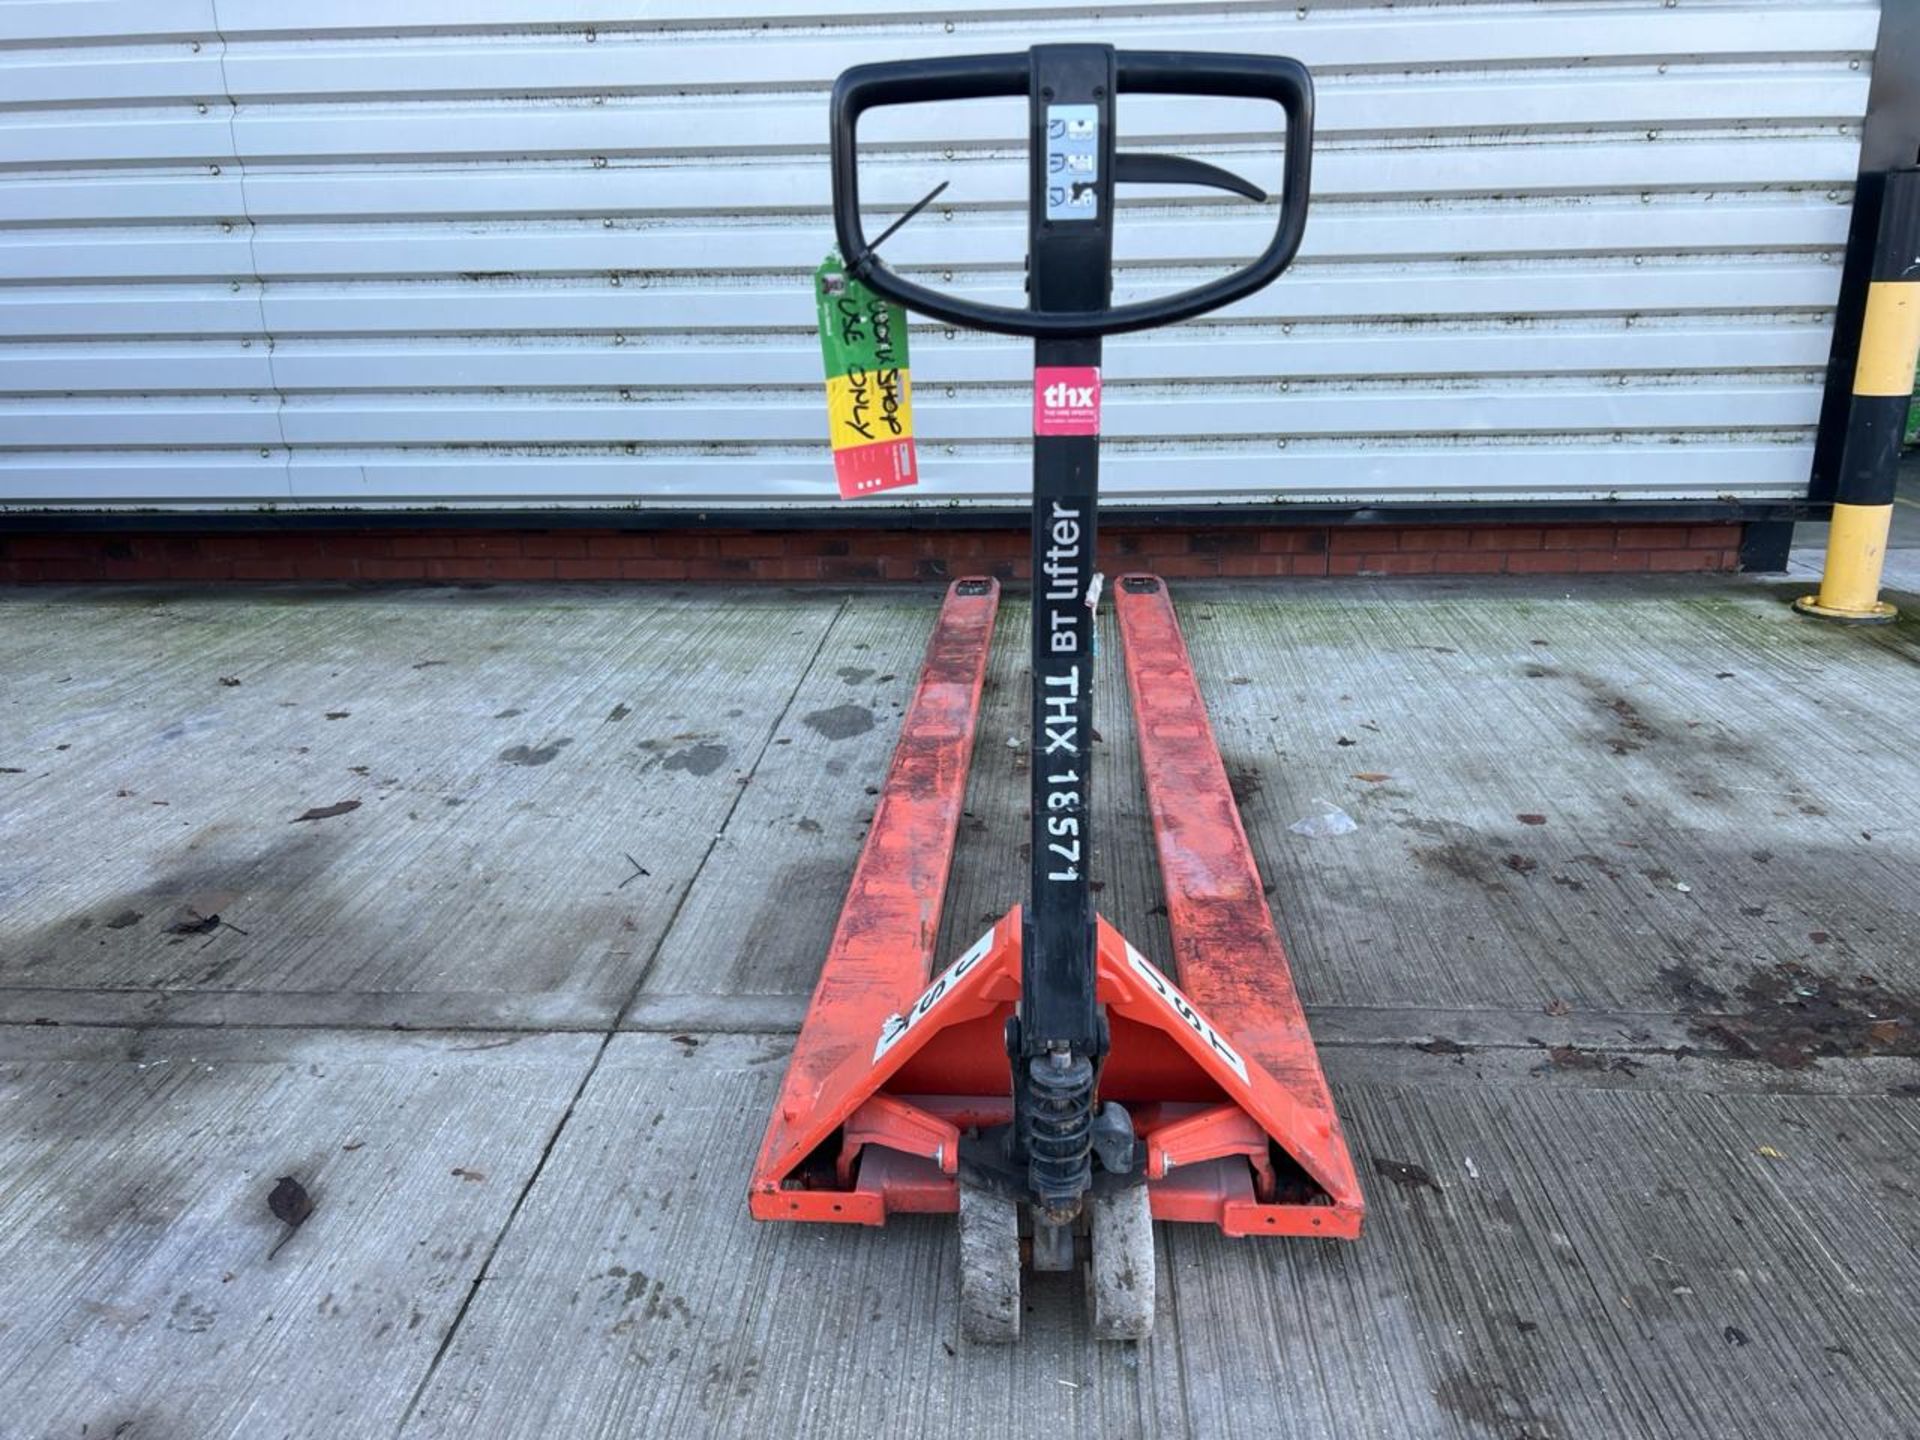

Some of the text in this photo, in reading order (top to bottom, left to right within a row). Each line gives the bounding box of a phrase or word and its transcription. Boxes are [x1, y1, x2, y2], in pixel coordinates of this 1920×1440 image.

[838, 298, 876, 440] USE ONLY
[1043, 381, 1095, 408] thx
[1051, 610, 1079, 652] BT
[1044, 665, 1081, 881] THX 18571
